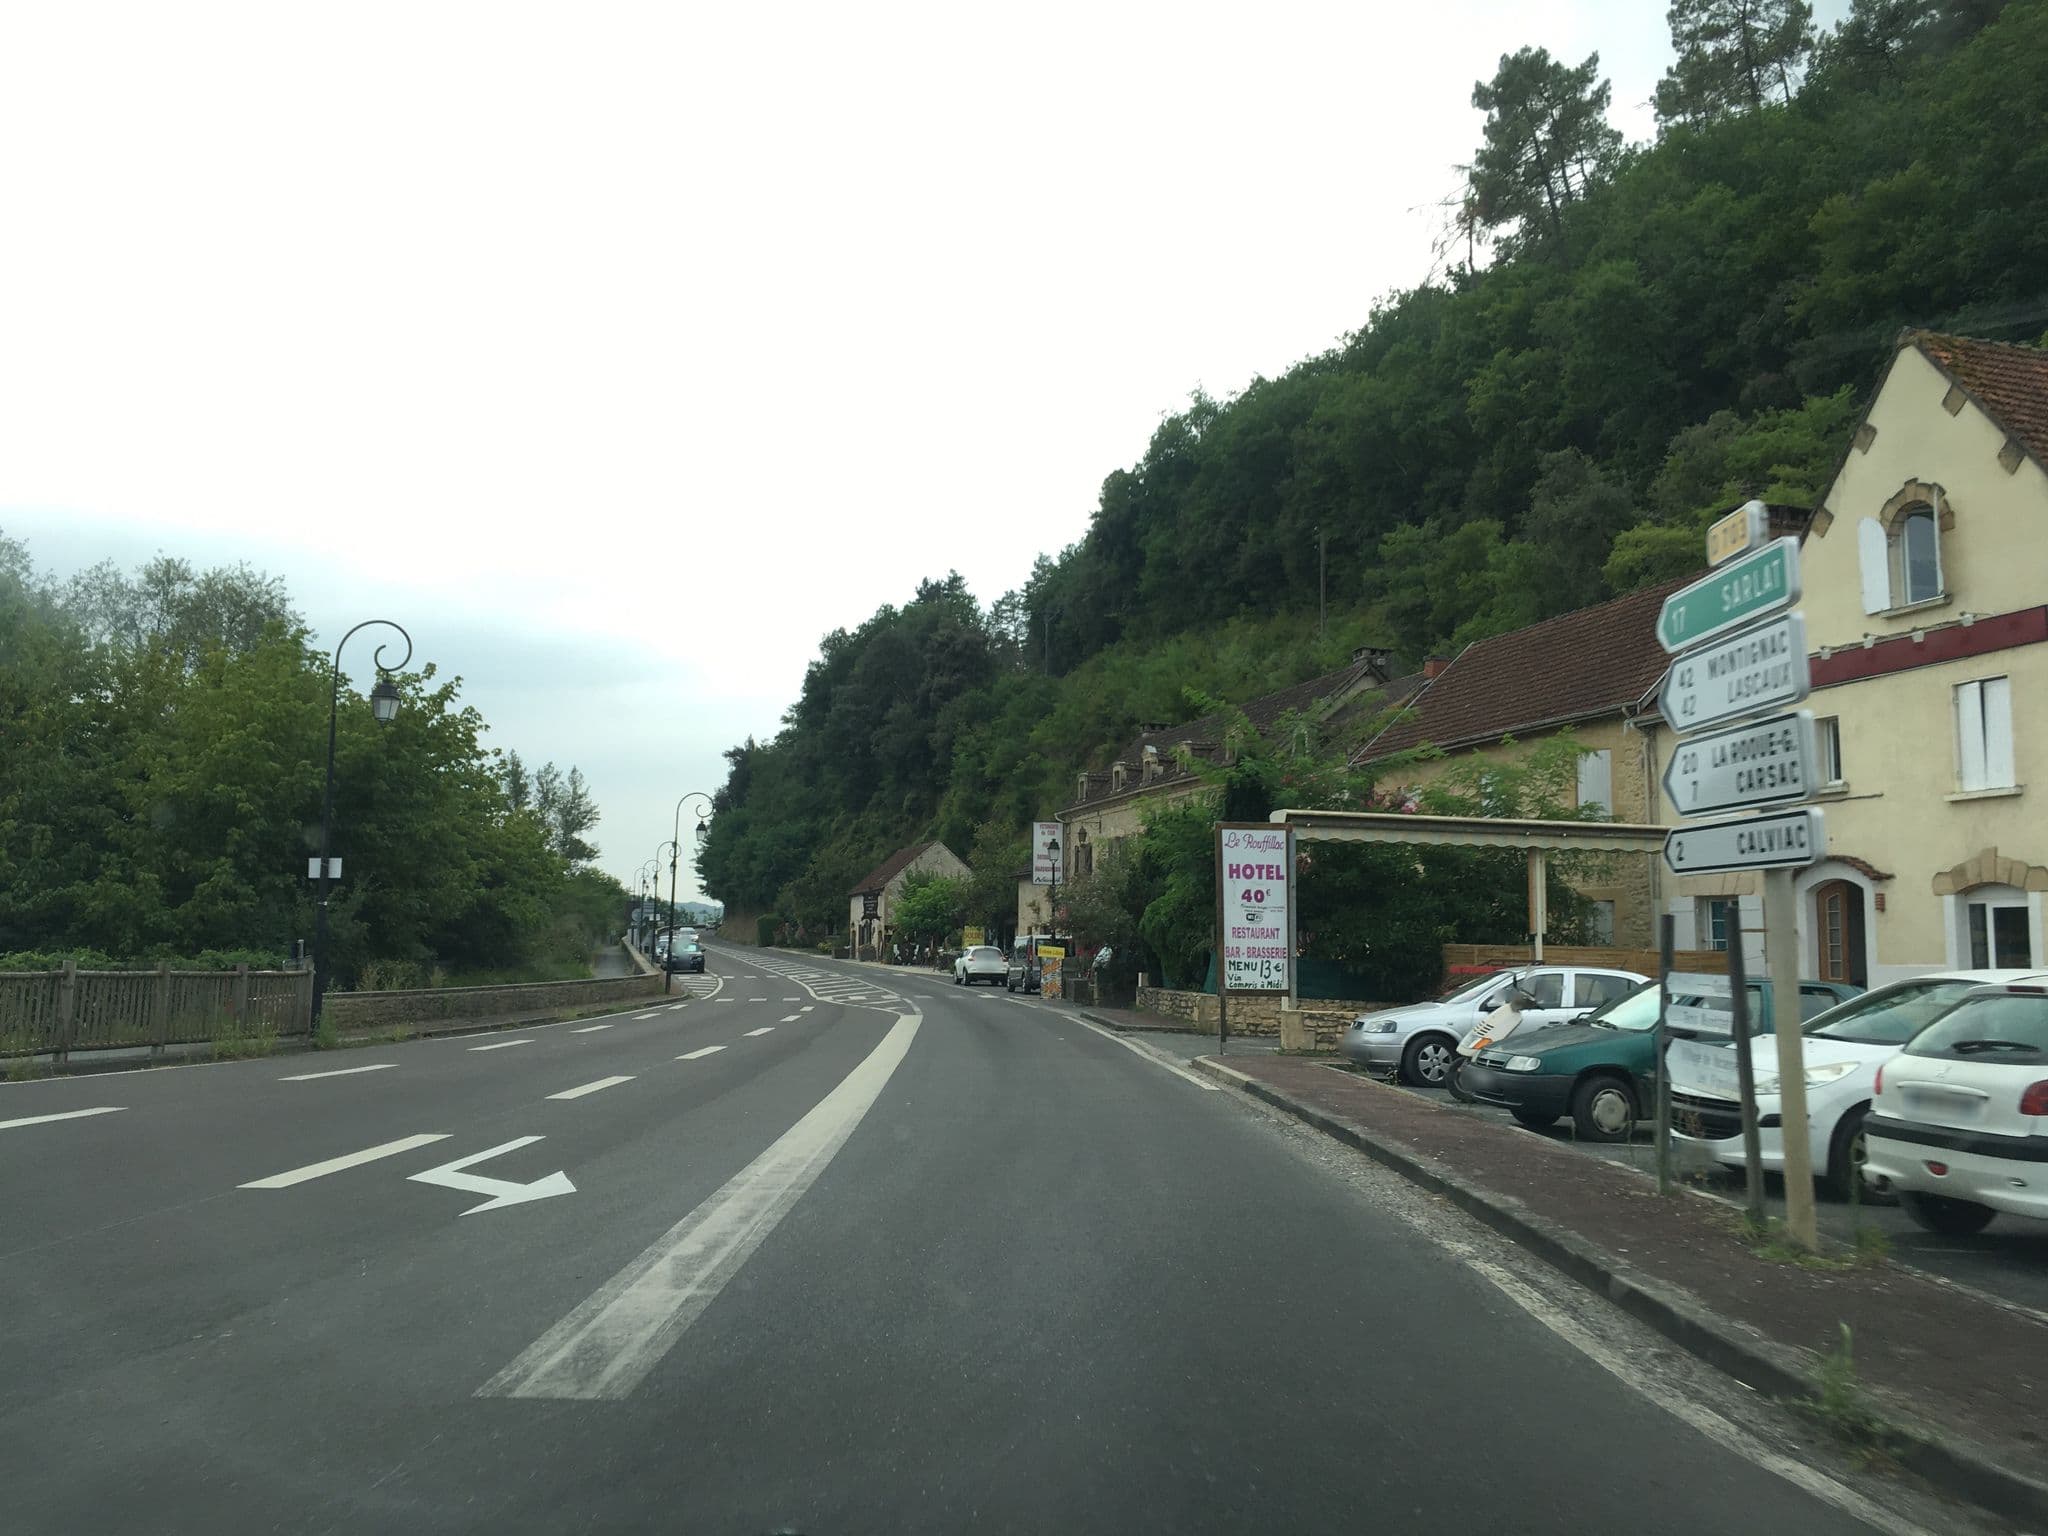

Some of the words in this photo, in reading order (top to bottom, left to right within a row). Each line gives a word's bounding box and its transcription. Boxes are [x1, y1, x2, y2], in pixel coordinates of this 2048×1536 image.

[1671, 605, 1687, 635] 17
[1720, 558, 1781, 612] SARLAT
[1707, 629, 1788, 681] MONTIGNAC
[1727, 662, 1793, 704] LASCAUX
[1711, 743, 1728, 769] LA
[1735, 760, 1800, 794] CARSAC
[1224, 832, 1239, 849] Le
[1675, 840, 1685, 862] 2
[1736, 824, 1807, 855] CALVIAC
[1228, 864, 1285, 881] HOTEL
[1231, 927, 1281, 940] RESTAURANT
[1225, 946, 1241, 958] BAR
[1246, 946, 1287, 959] BRASSERIE
[1228, 960, 1258, 972] MENU
[1260, 959, 1271, 979] 13
[1266, 979, 1283, 989] Midi
